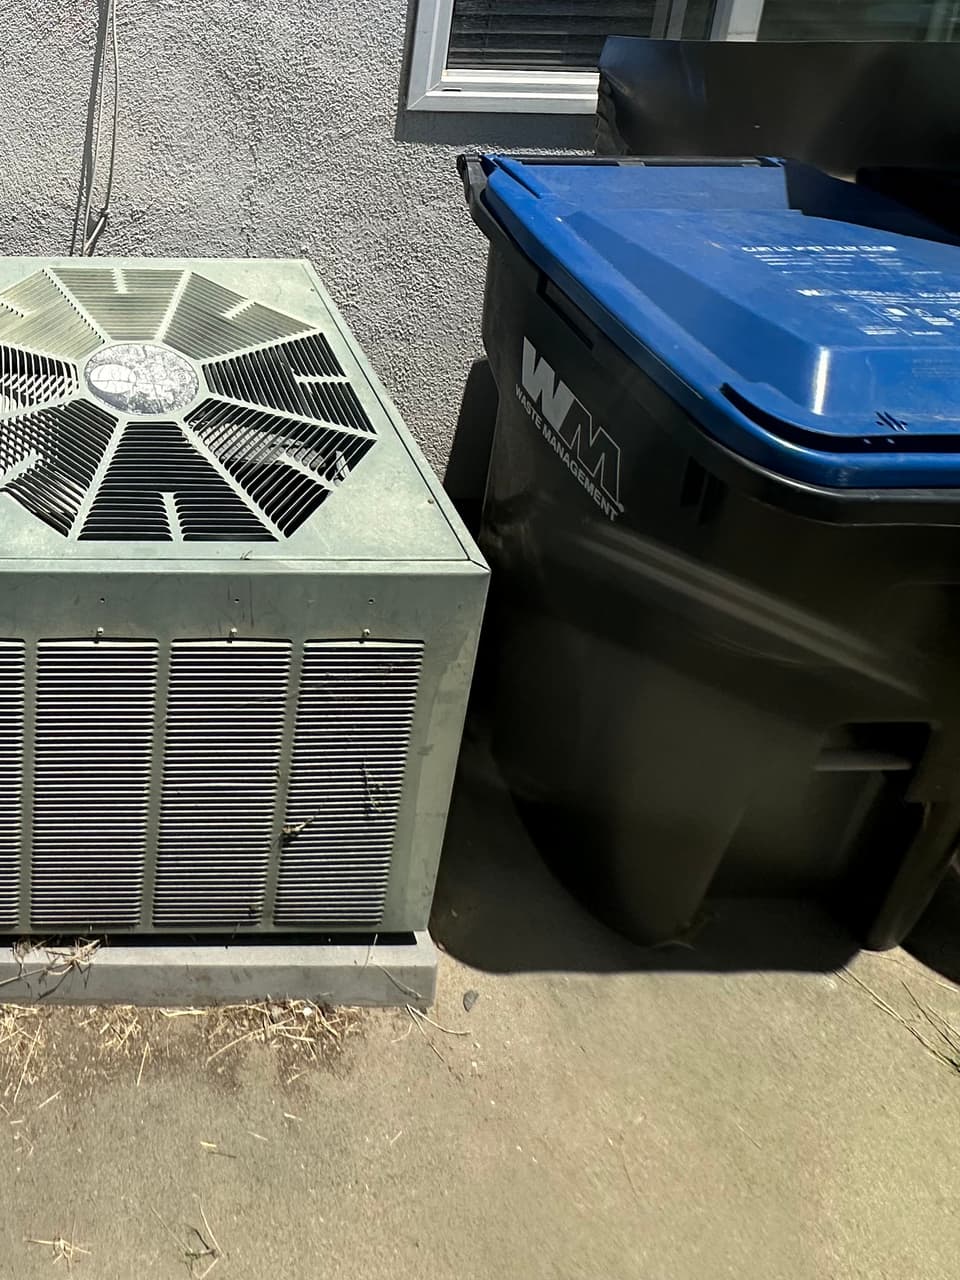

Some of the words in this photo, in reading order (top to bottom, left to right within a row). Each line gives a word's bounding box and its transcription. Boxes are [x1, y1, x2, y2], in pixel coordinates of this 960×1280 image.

[515, 383, 542, 430] WASTE
[542, 424, 619, 521] MANAGEMENT
[522, 336, 620, 505] WM
